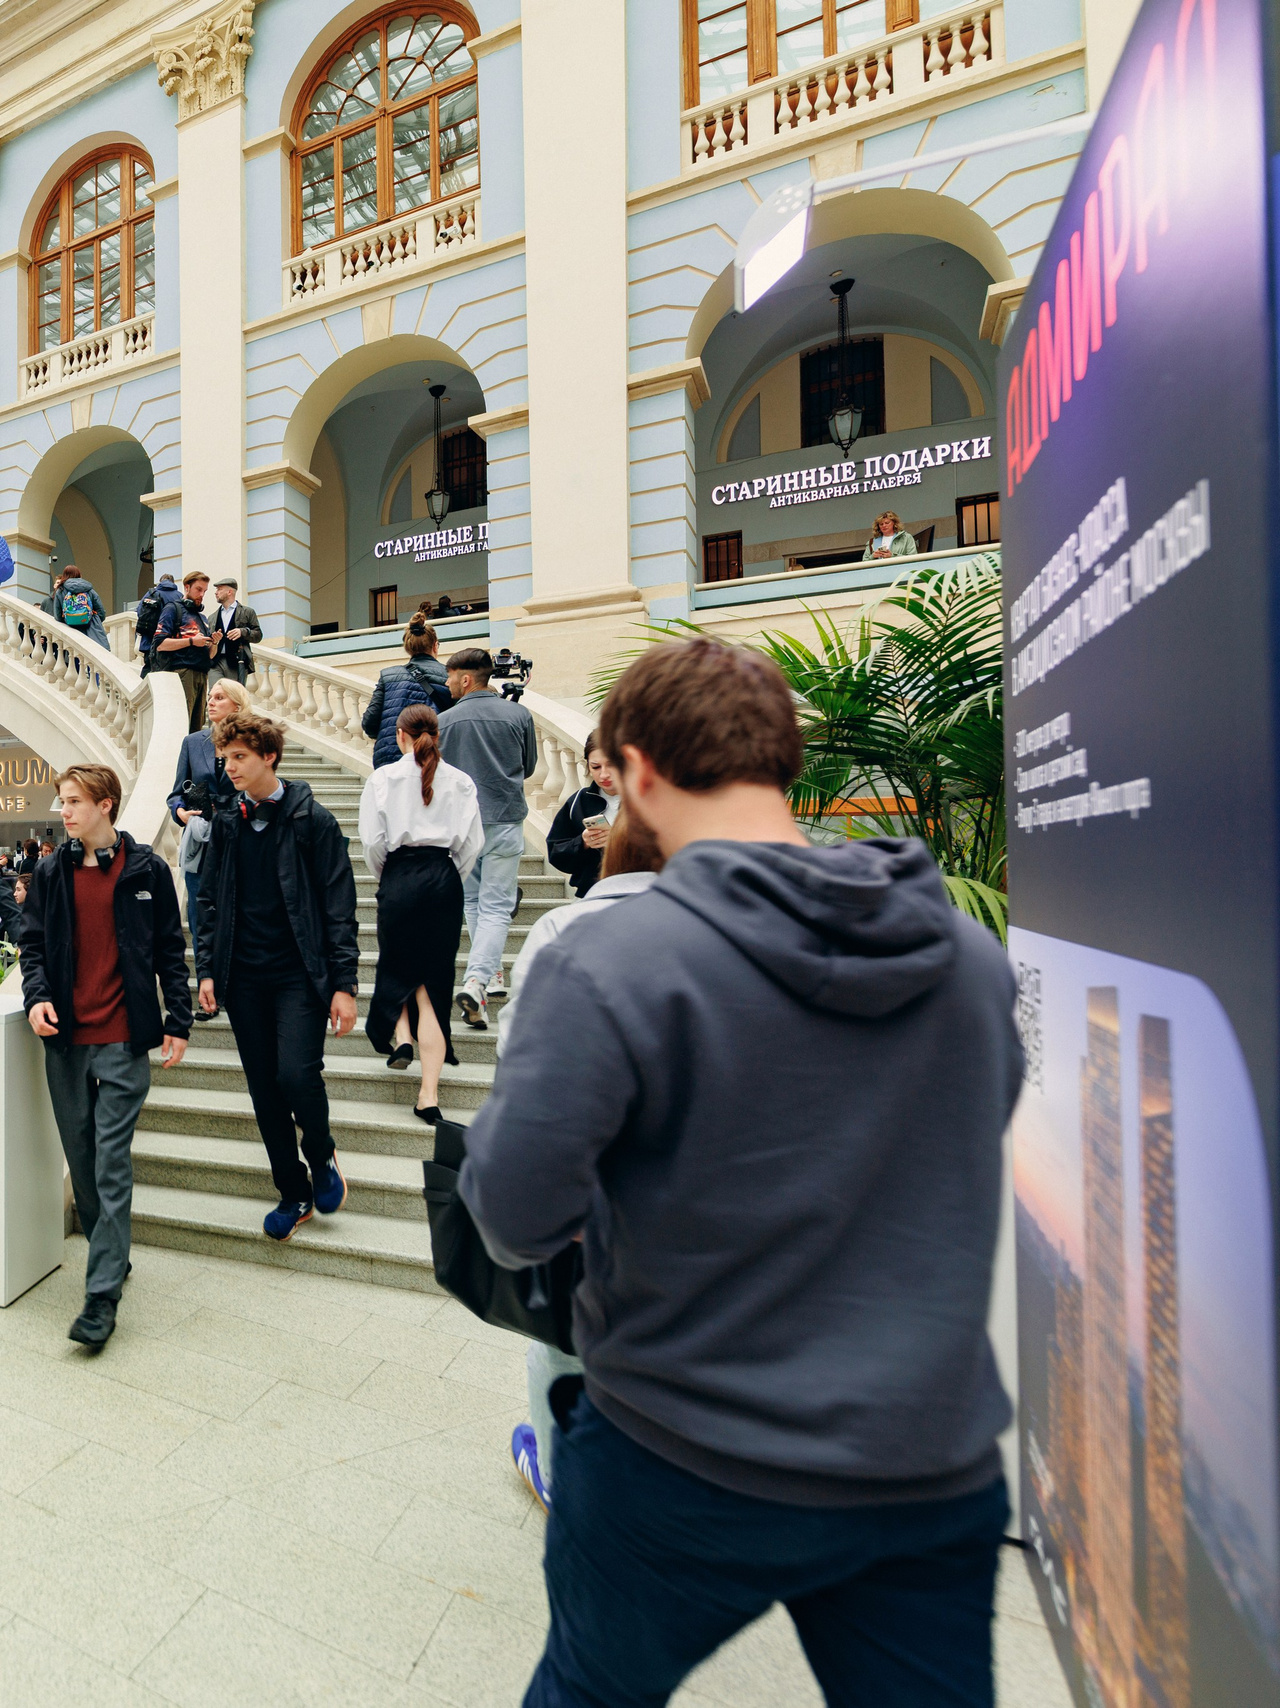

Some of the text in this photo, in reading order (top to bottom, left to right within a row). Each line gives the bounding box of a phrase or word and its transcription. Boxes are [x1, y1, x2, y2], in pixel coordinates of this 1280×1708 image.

[711, 436, 991, 505] СТАРИННЫЕ ПОДАРКИ
[769, 472, 922, 509] АНТИКВАРНАЯ ГАЛЕРЕЯ
[374, 525, 474, 559] СТАРИННЫЕ
[414, 543, 476, 563] АНТИКВАРНАЯ
